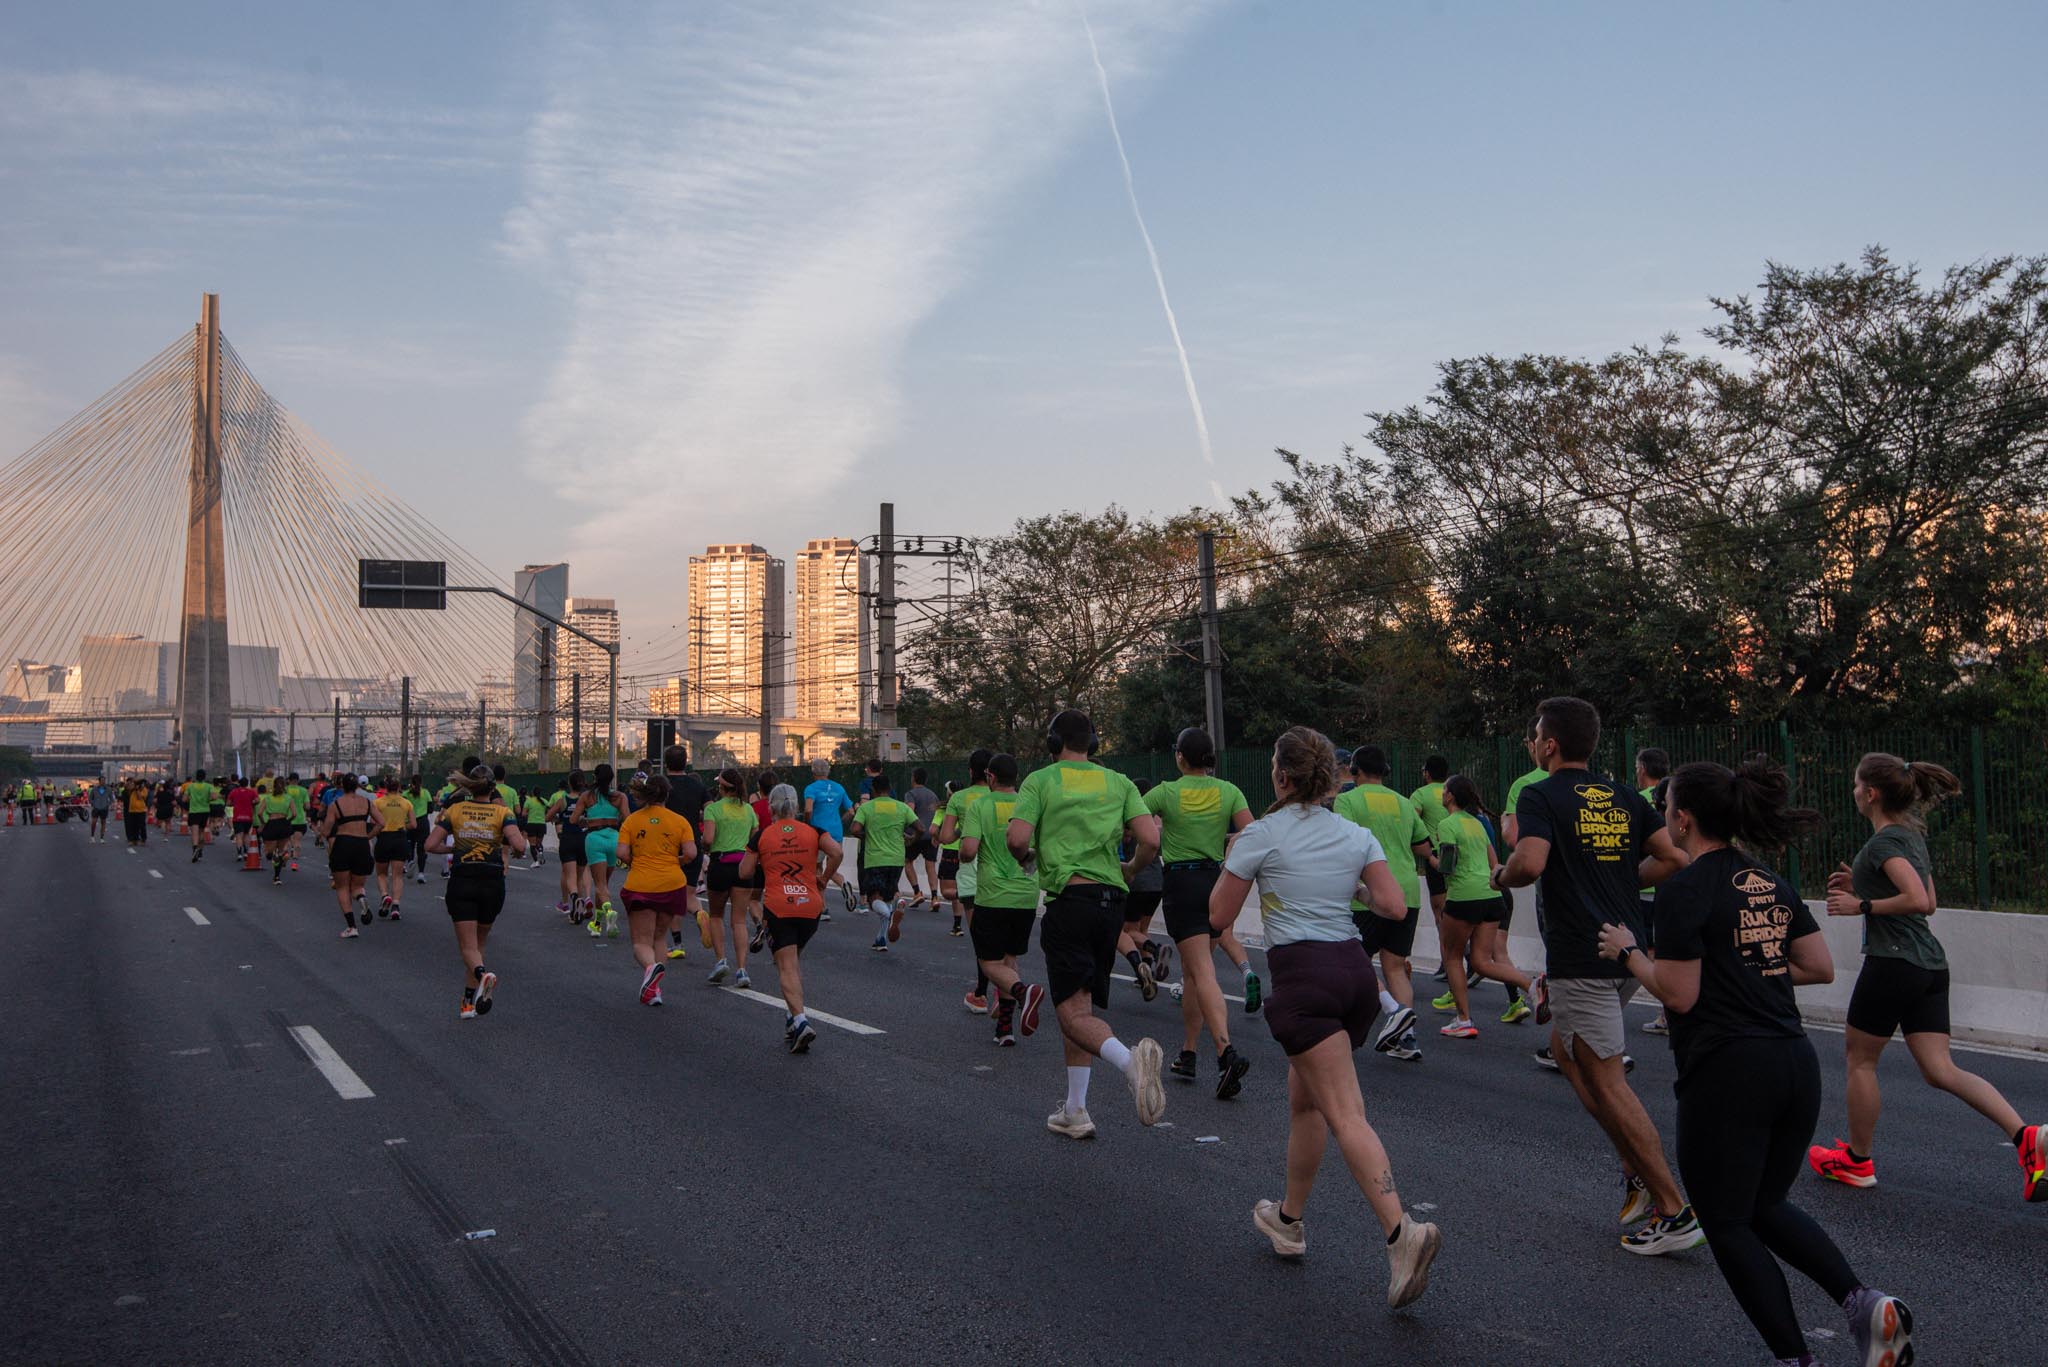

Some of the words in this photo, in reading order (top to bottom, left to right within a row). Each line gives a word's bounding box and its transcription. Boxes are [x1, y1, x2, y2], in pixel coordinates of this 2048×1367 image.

[1580, 809, 1606, 823] RUN
[1609, 810, 1627, 822] the
[1581, 823, 1629, 834] BRIDGE
[1592, 835, 1622, 847] 10K
[785, 885, 807, 893] BDO
[1739, 909, 1770, 928] RUN
[1772, 907, 1789, 924] the
[1740, 925, 1788, 944] BRIDGE
[1761, 941, 1783, 958] 5K
